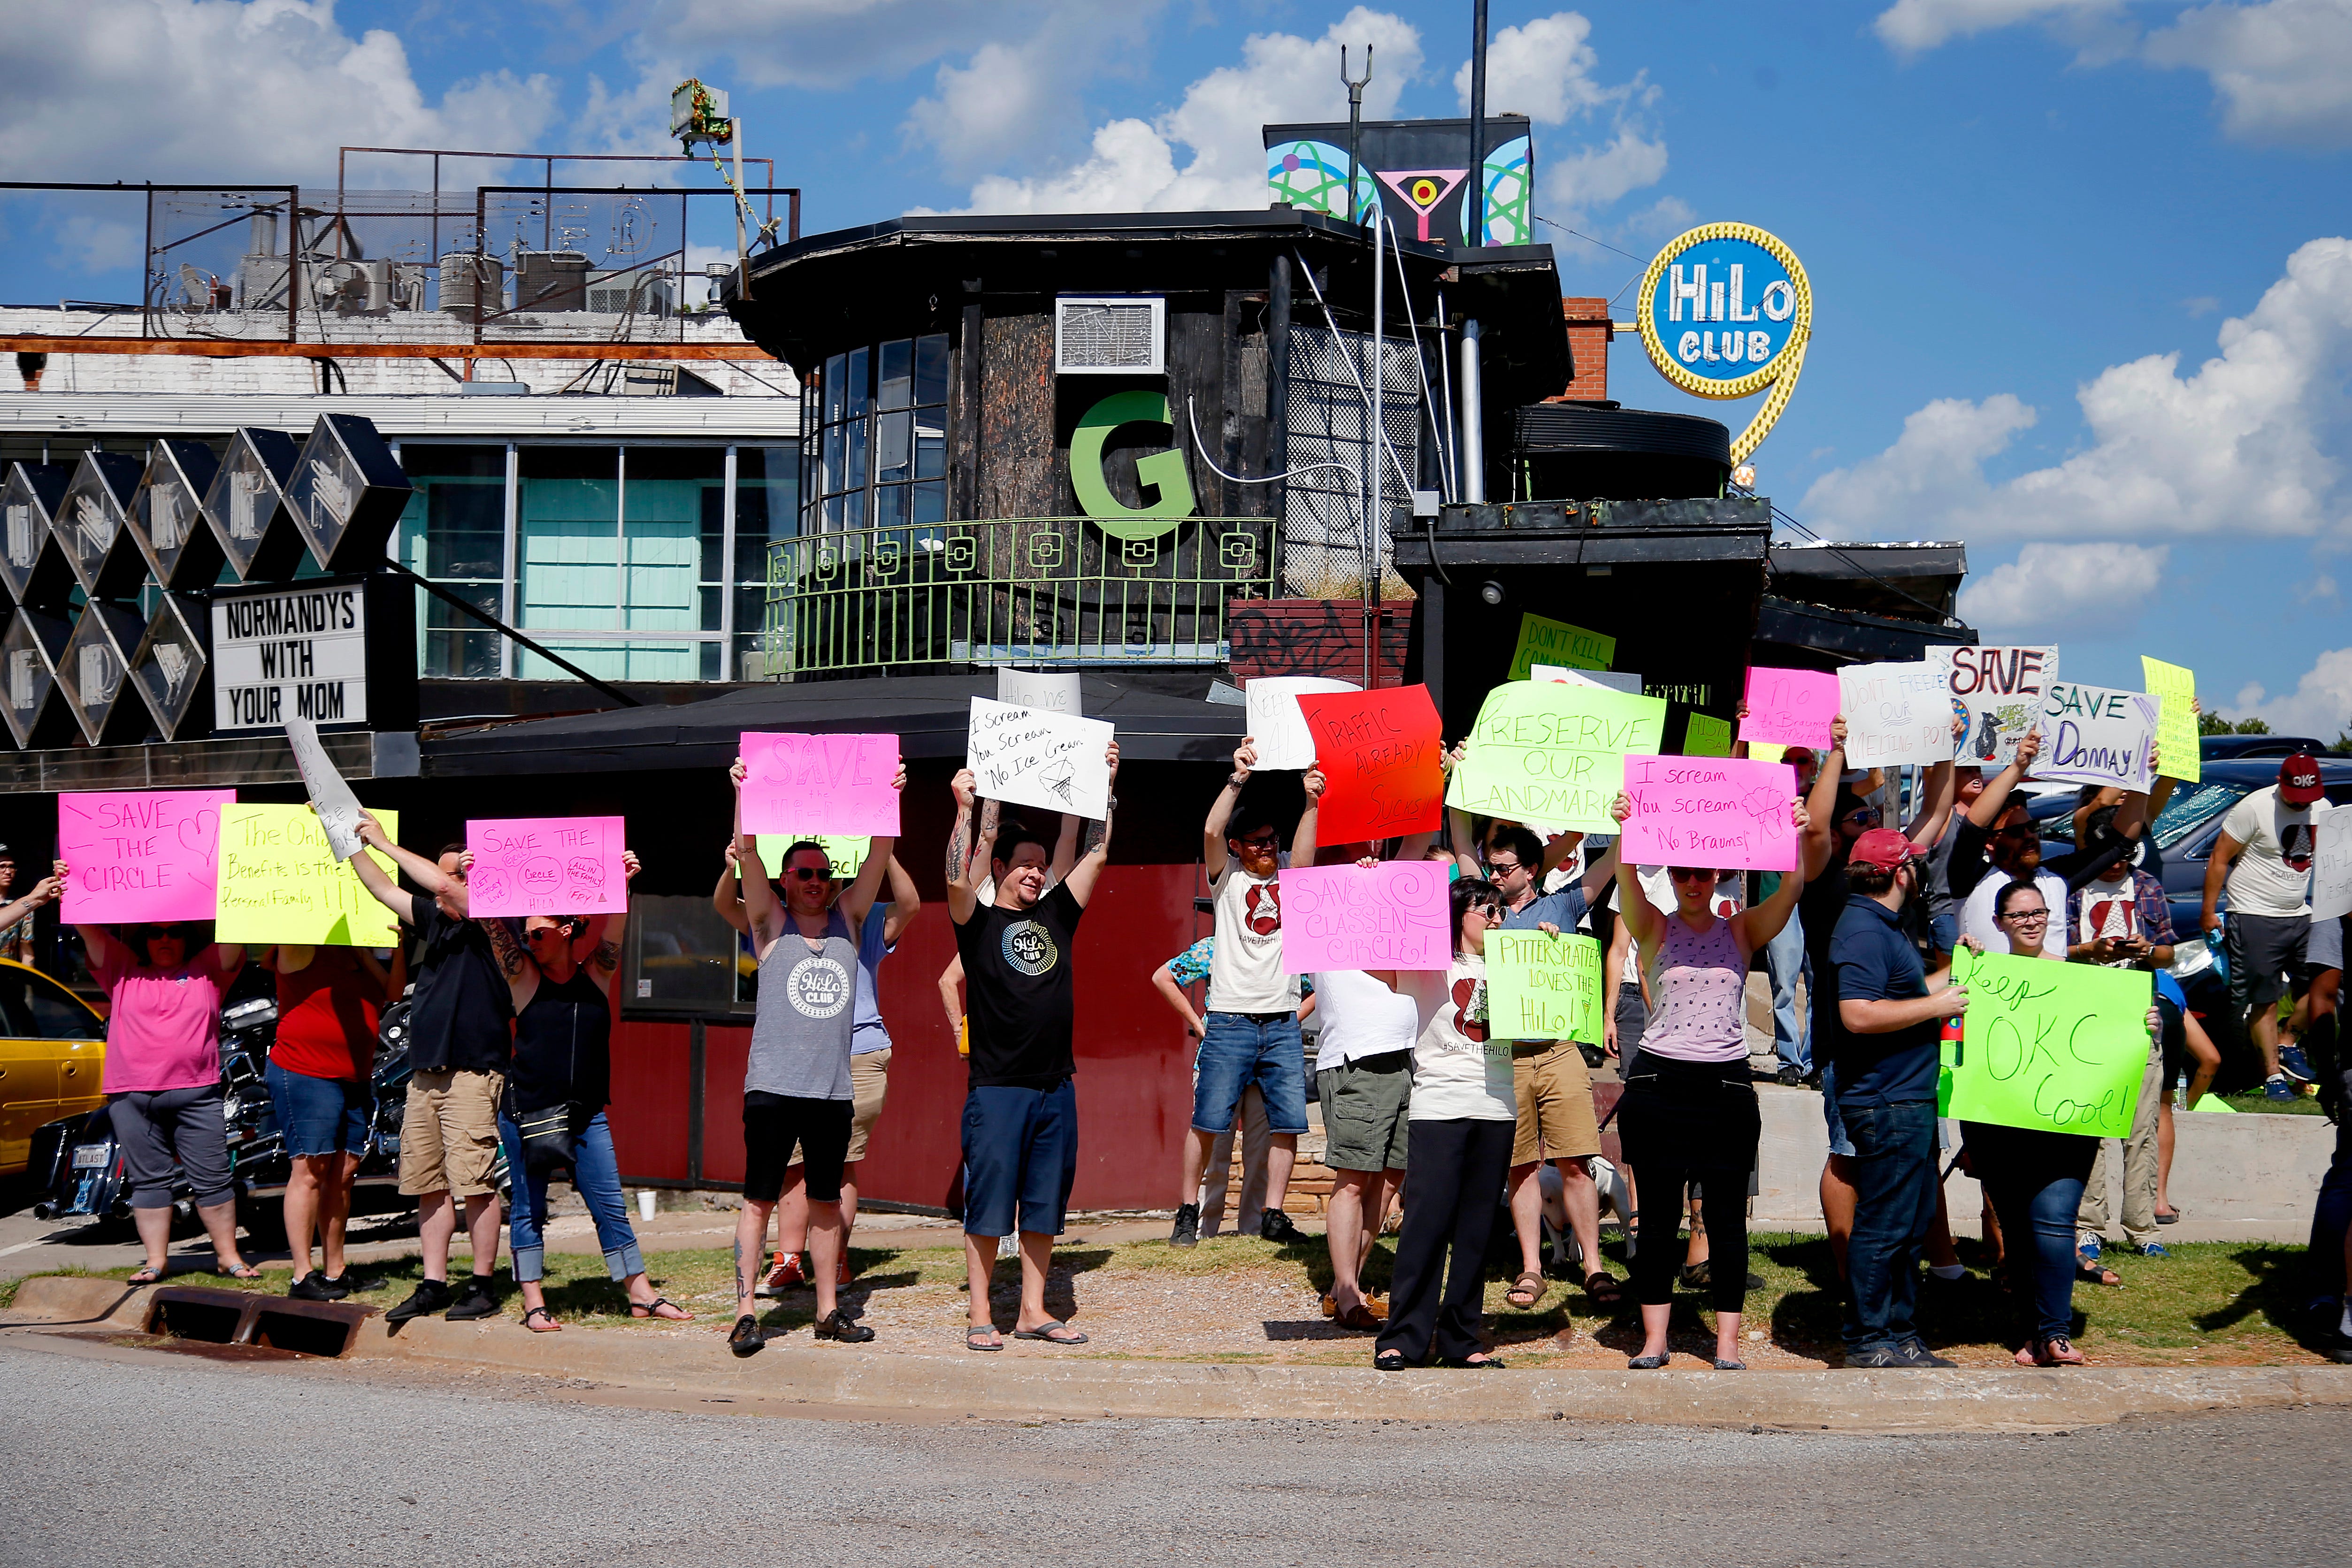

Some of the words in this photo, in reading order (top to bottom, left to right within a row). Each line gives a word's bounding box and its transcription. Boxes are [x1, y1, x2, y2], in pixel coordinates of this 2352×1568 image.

[1678, 330, 1771, 363] CLUB
[1070, 390, 1196, 540] G
[226, 591, 354, 639] NORMANDYS
[260, 640, 313, 679] WITH
[1571, 635, 1604, 663] KILL
[1949, 647, 2045, 695] SAVE
[2147, 660, 2189, 690] HILO
[229, 687, 282, 725] YOUR
[298, 682, 344, 720] MOM
[1248, 682, 1288, 719] KEEP
[1880, 701, 1912, 720] OUR
[2045, 686, 2129, 719] SAVE
[969, 716, 980, 736] I
[985, 710, 1032, 729] Scream
[1308, 708, 1402, 748] TRAFFIC
[1478, 694, 1650, 747] PRESERVE
[968, 741, 995, 765] You
[999, 727, 1051, 750] Scream
[1852, 732, 1912, 759] MELTING
[1924, 726, 1949, 748] POT
[2165, 730, 2192, 746] HUMANE
[763, 737, 877, 788] SAVE
[1011, 756, 1040, 776] Ice
[1356, 740, 1425, 779] ALREADY
[1524, 751, 1594, 782] OUR
[1636, 761, 1655, 783] I
[1664, 769, 1727, 783] scream
[809, 789, 830, 798] the
[2293, 774, 2316, 787] OKC
[99, 799, 173, 829] SAVE
[1630, 789, 1660, 817] You
[1671, 798, 1737, 812] scream
[232, 813, 280, 846] The
[483, 829, 541, 852] SAVE
[554, 829, 595, 848] THE
[103, 836, 157, 858] THE
[84, 864, 173, 891] CIRCLE
[227, 853, 288, 879] Benefits
[295, 861, 310, 875] is
[314, 861, 346, 877] the
[568, 868, 579, 877] THE
[580, 872, 604, 887] FAMILY
[573, 862, 586, 871] ALL
[474, 874, 488, 888] LET
[1292, 876, 1368, 913] SAVE
[272, 888, 313, 912] Family
[488, 889, 506, 903] LIVE
[571, 891, 592, 905] FRY
[1306, 906, 1407, 938] CLASSEN
[1327, 935, 1428, 965] CIRCLE!
[1529, 969, 1572, 991] LOVES
[1574, 973, 1595, 996] THE
[805, 992, 835, 1003] CLUB
[1443, 1041, 1509, 1057] #SAVETHEHILO
[1987, 1013, 2105, 1081] OKC
[77, 1154, 103, 1163] ATLAST
